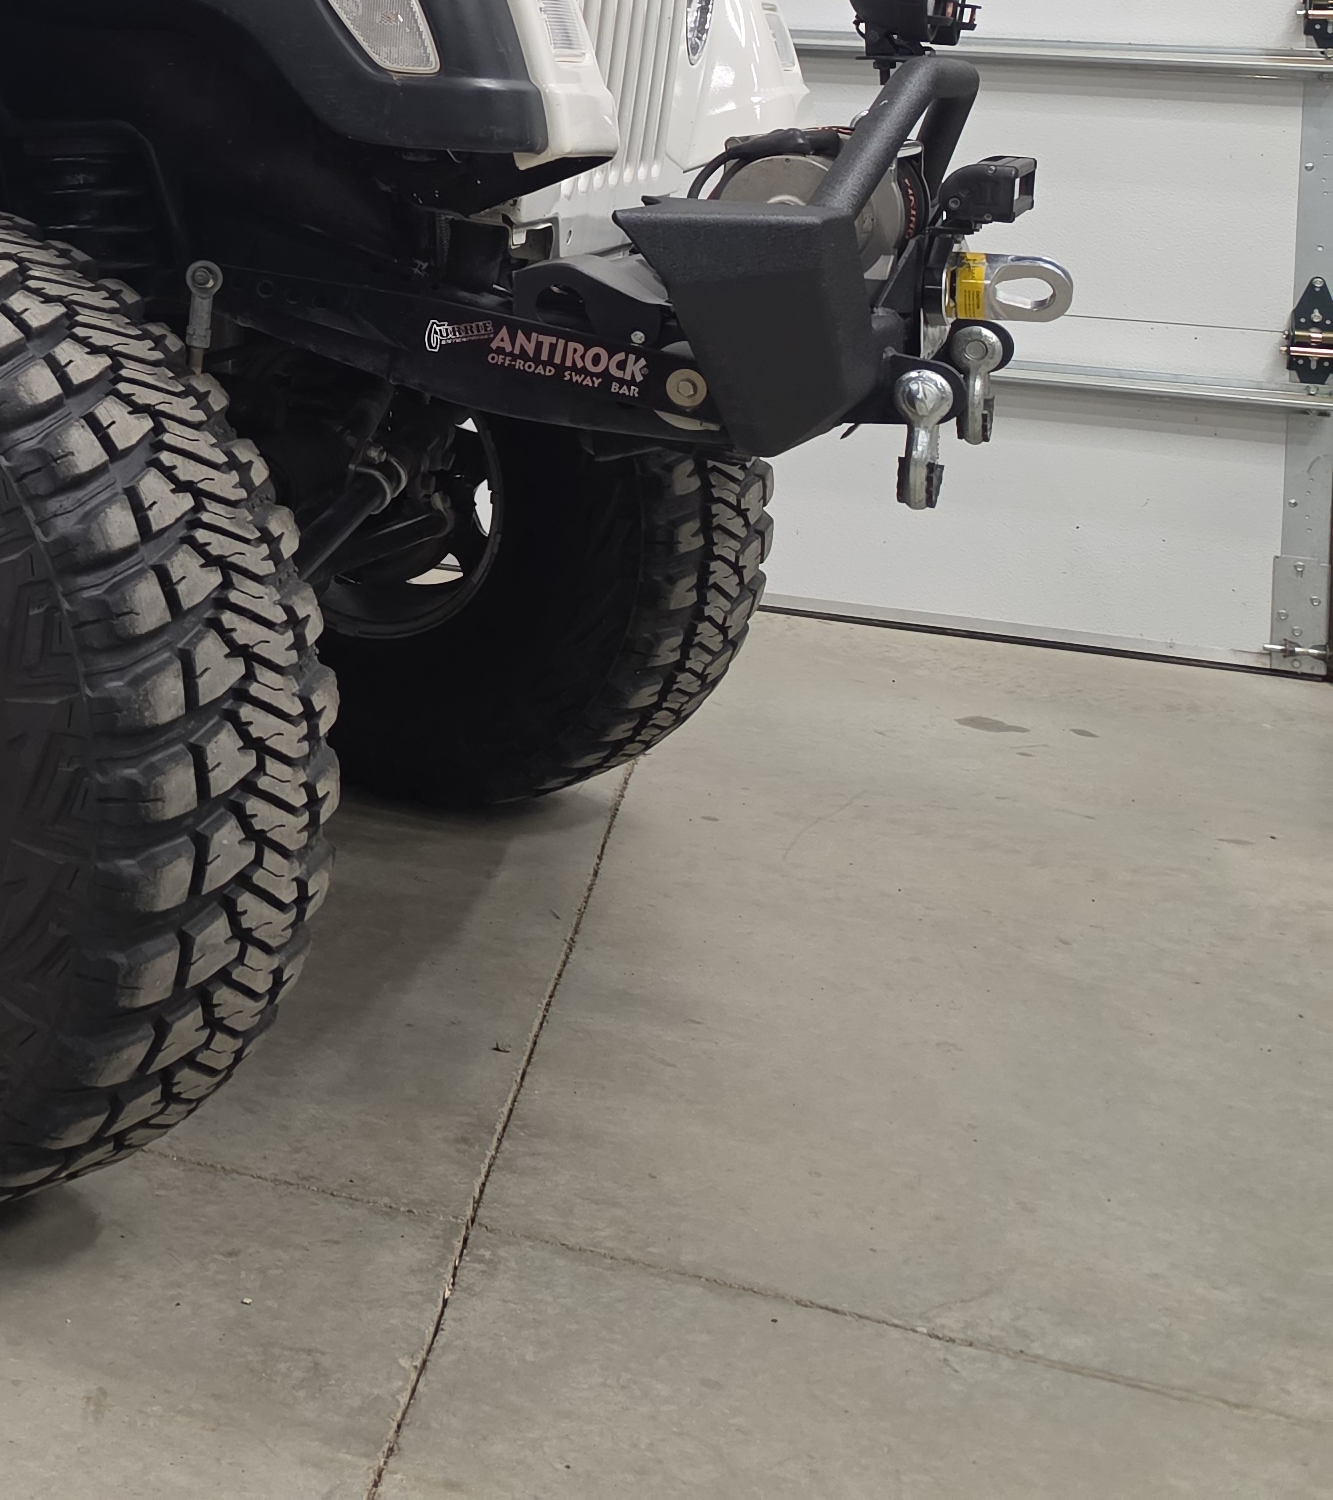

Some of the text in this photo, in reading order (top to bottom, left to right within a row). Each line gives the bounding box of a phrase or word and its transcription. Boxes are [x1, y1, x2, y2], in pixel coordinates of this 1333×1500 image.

[487, 353, 640, 398] OFF-ROAD SWAY BAR
